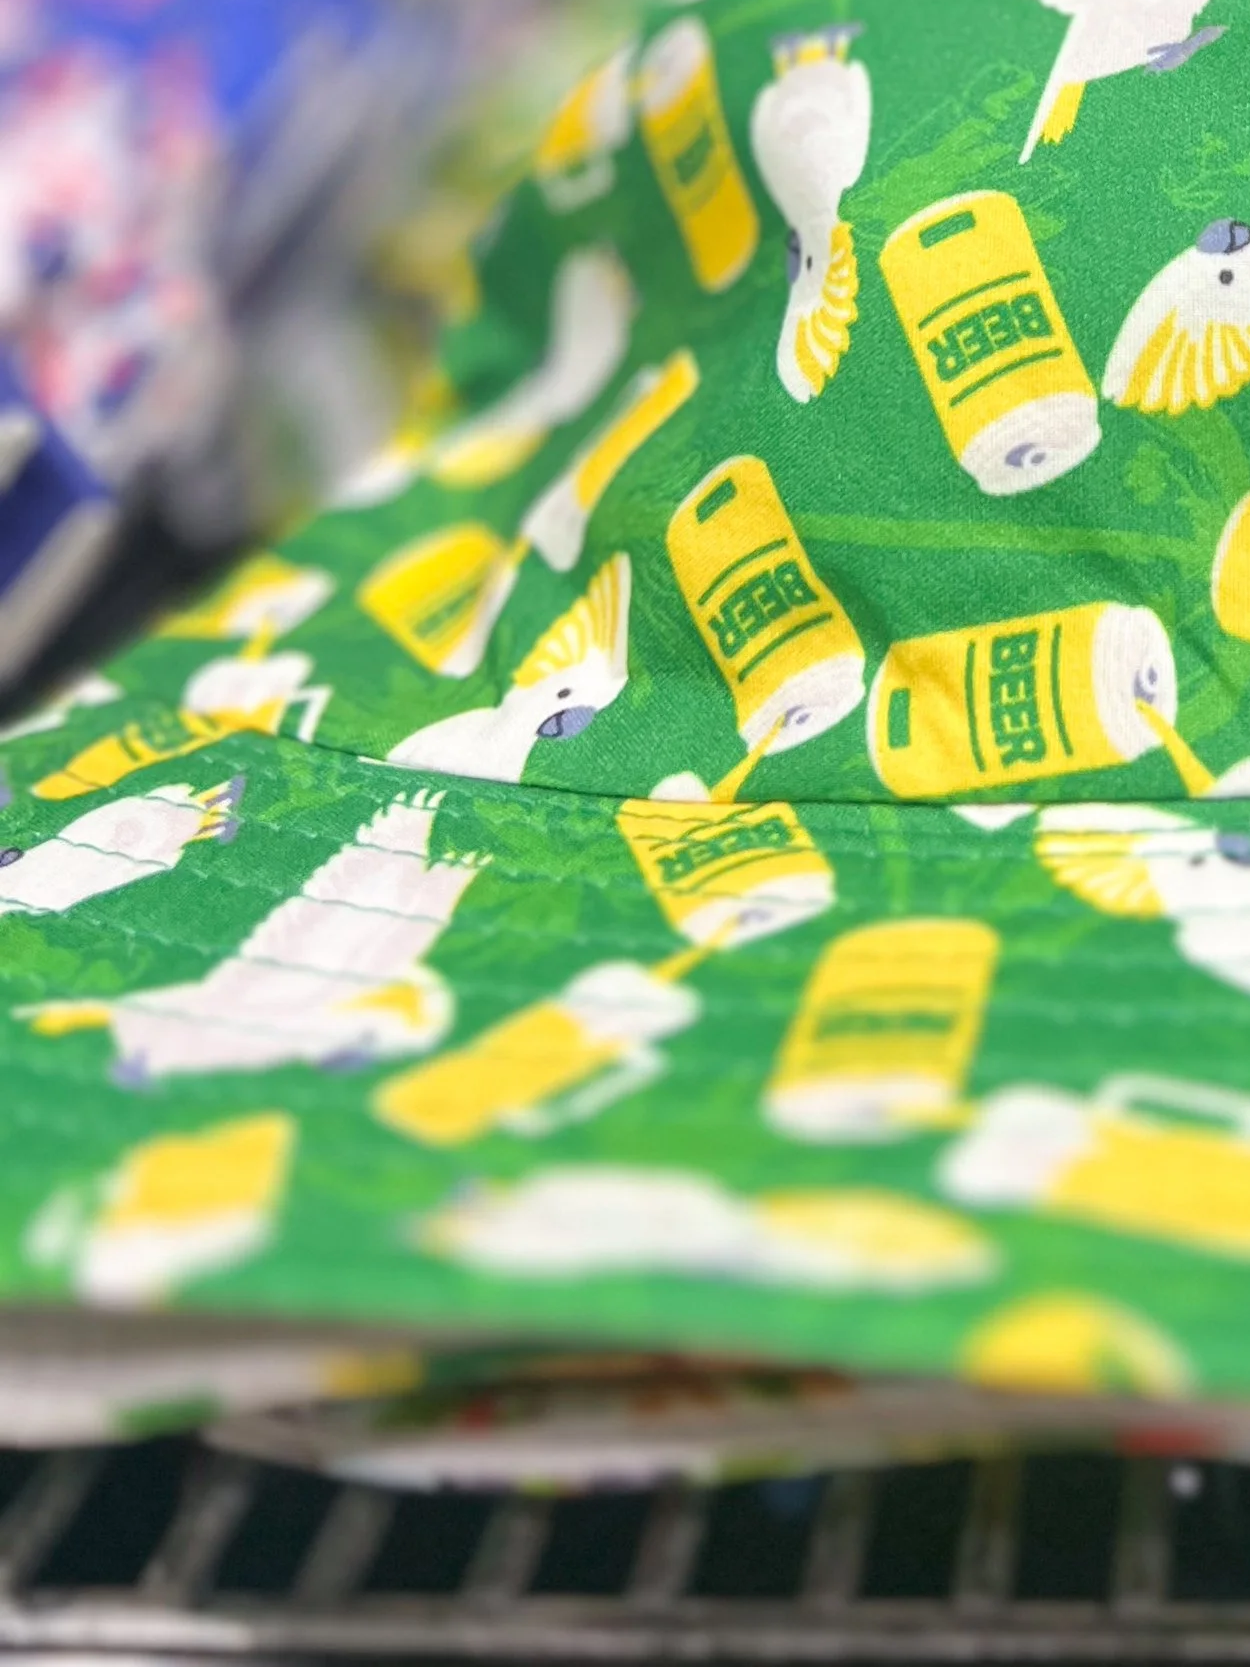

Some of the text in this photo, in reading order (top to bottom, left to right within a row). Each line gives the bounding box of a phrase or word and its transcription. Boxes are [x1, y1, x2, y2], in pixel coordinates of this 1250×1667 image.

[927, 291, 1054, 381] BEER
[708, 558, 820, 658] BEER
[989, 629, 1047, 768] BEER
[653, 814, 793, 883] BEER
